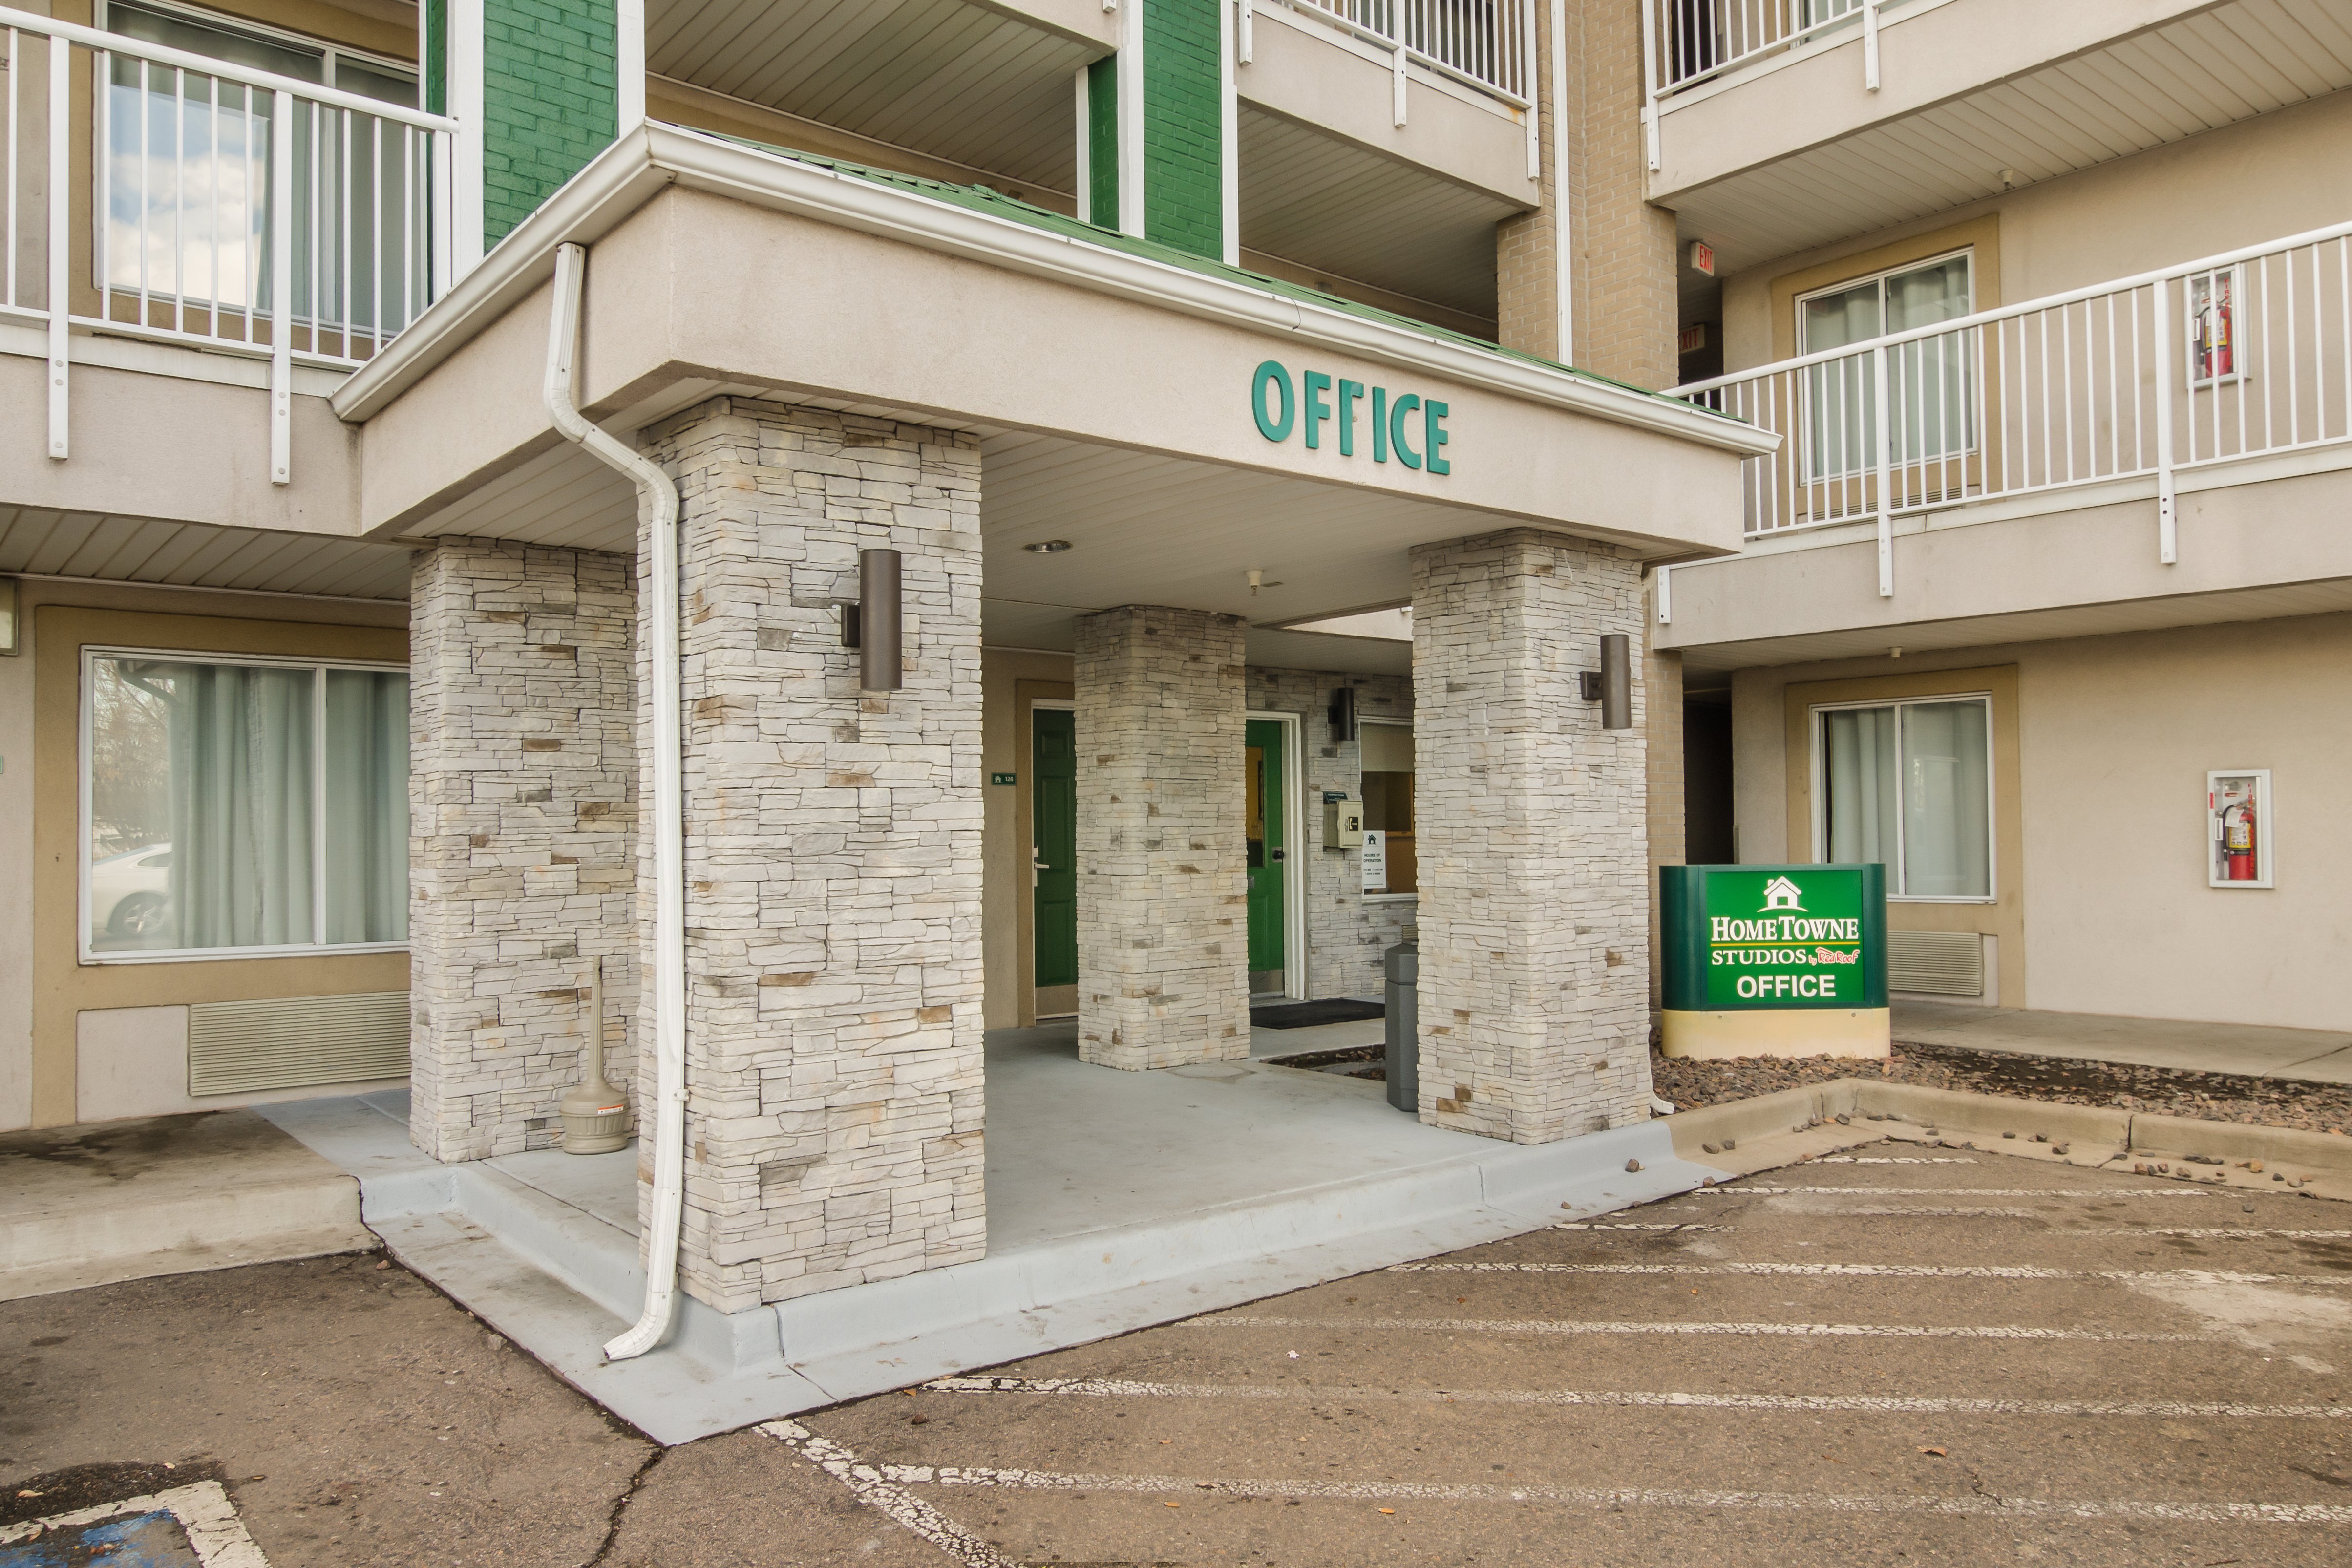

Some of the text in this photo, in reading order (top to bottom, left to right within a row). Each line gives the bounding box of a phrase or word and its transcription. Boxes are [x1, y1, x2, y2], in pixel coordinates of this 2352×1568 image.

[1699, 245, 1713, 272] EXIT
[1251, 360, 1450, 475] OFFICE
[1712, 949, 1860, 966] STUDIOS by Red Roof
[1737, 975, 1836, 998] OFFICE
